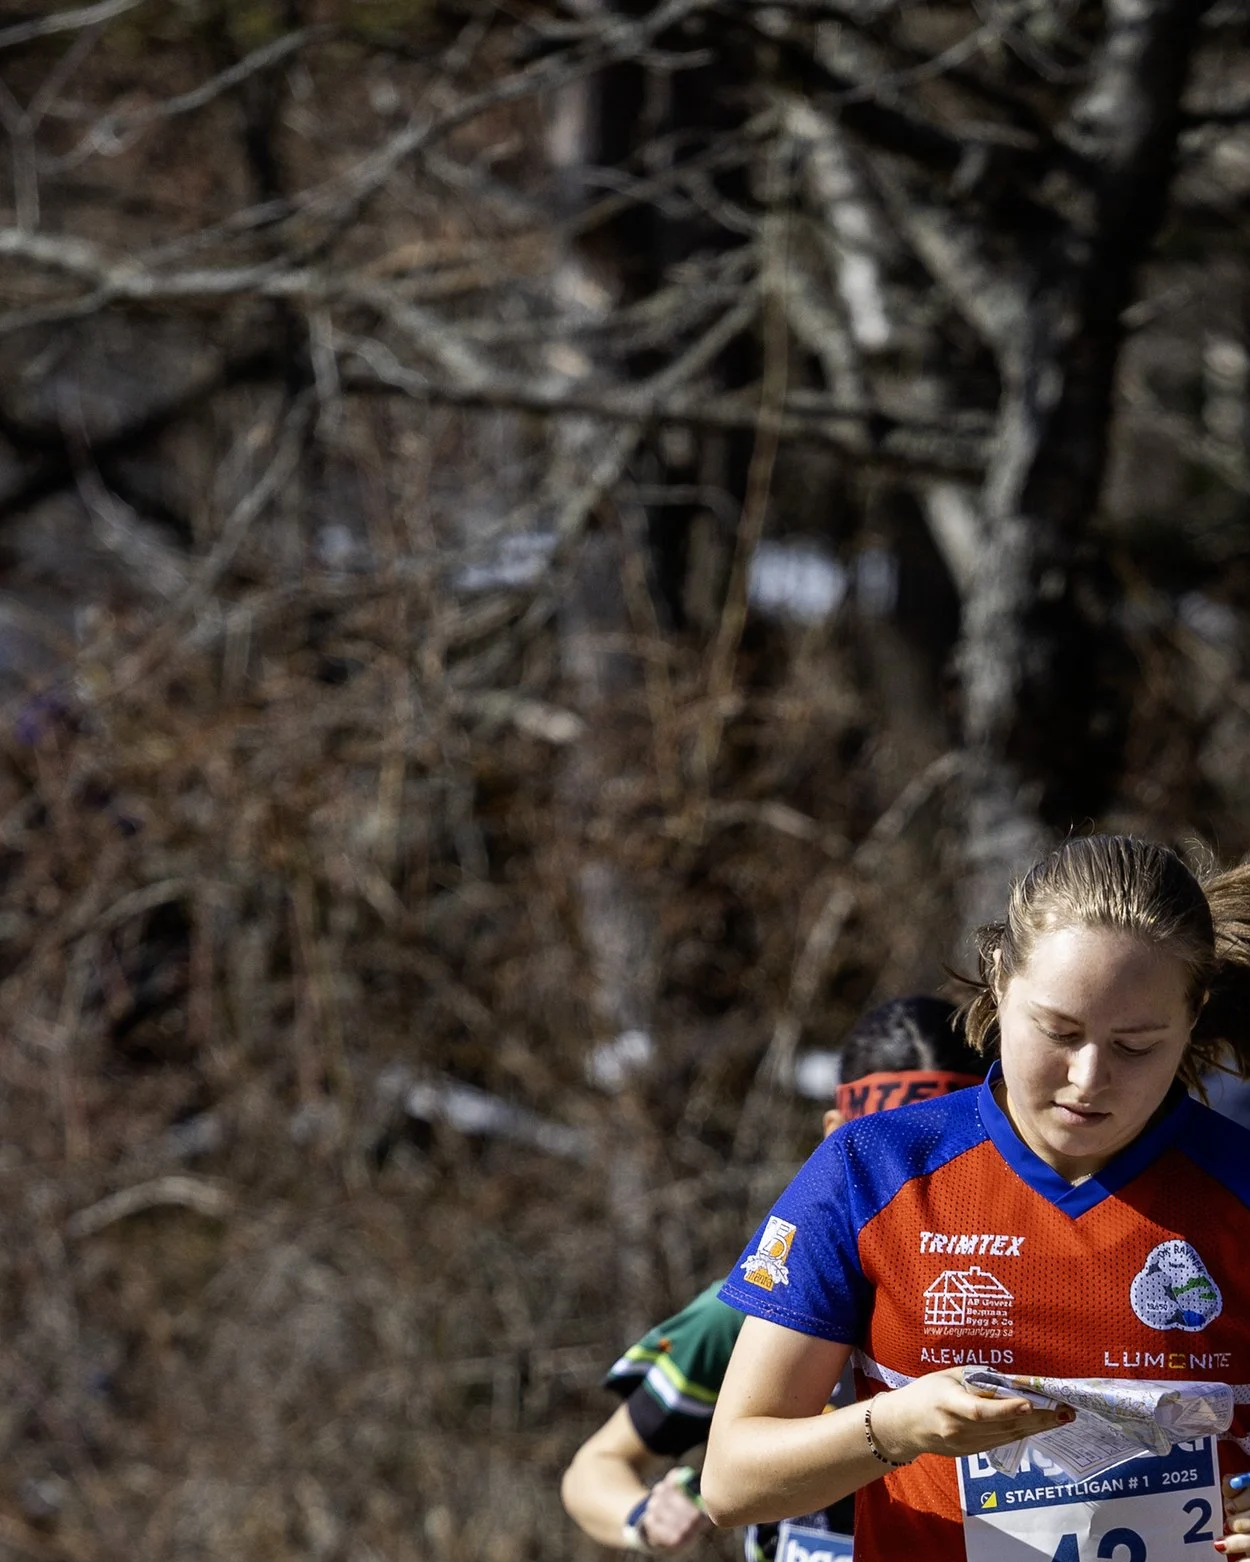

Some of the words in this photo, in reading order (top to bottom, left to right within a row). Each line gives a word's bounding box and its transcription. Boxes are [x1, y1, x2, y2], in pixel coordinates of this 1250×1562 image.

[920, 1231, 1026, 1256] TRIMTEX
[920, 1347, 1014, 1364] ALEWALDS
[1104, 1351, 1232, 1369] LUMONITE
[1005, 1478, 1124, 1504] STAFETTLIGAN
[1161, 1468, 1198, 1485] 2025
[1182, 1498, 1214, 1544] 2
